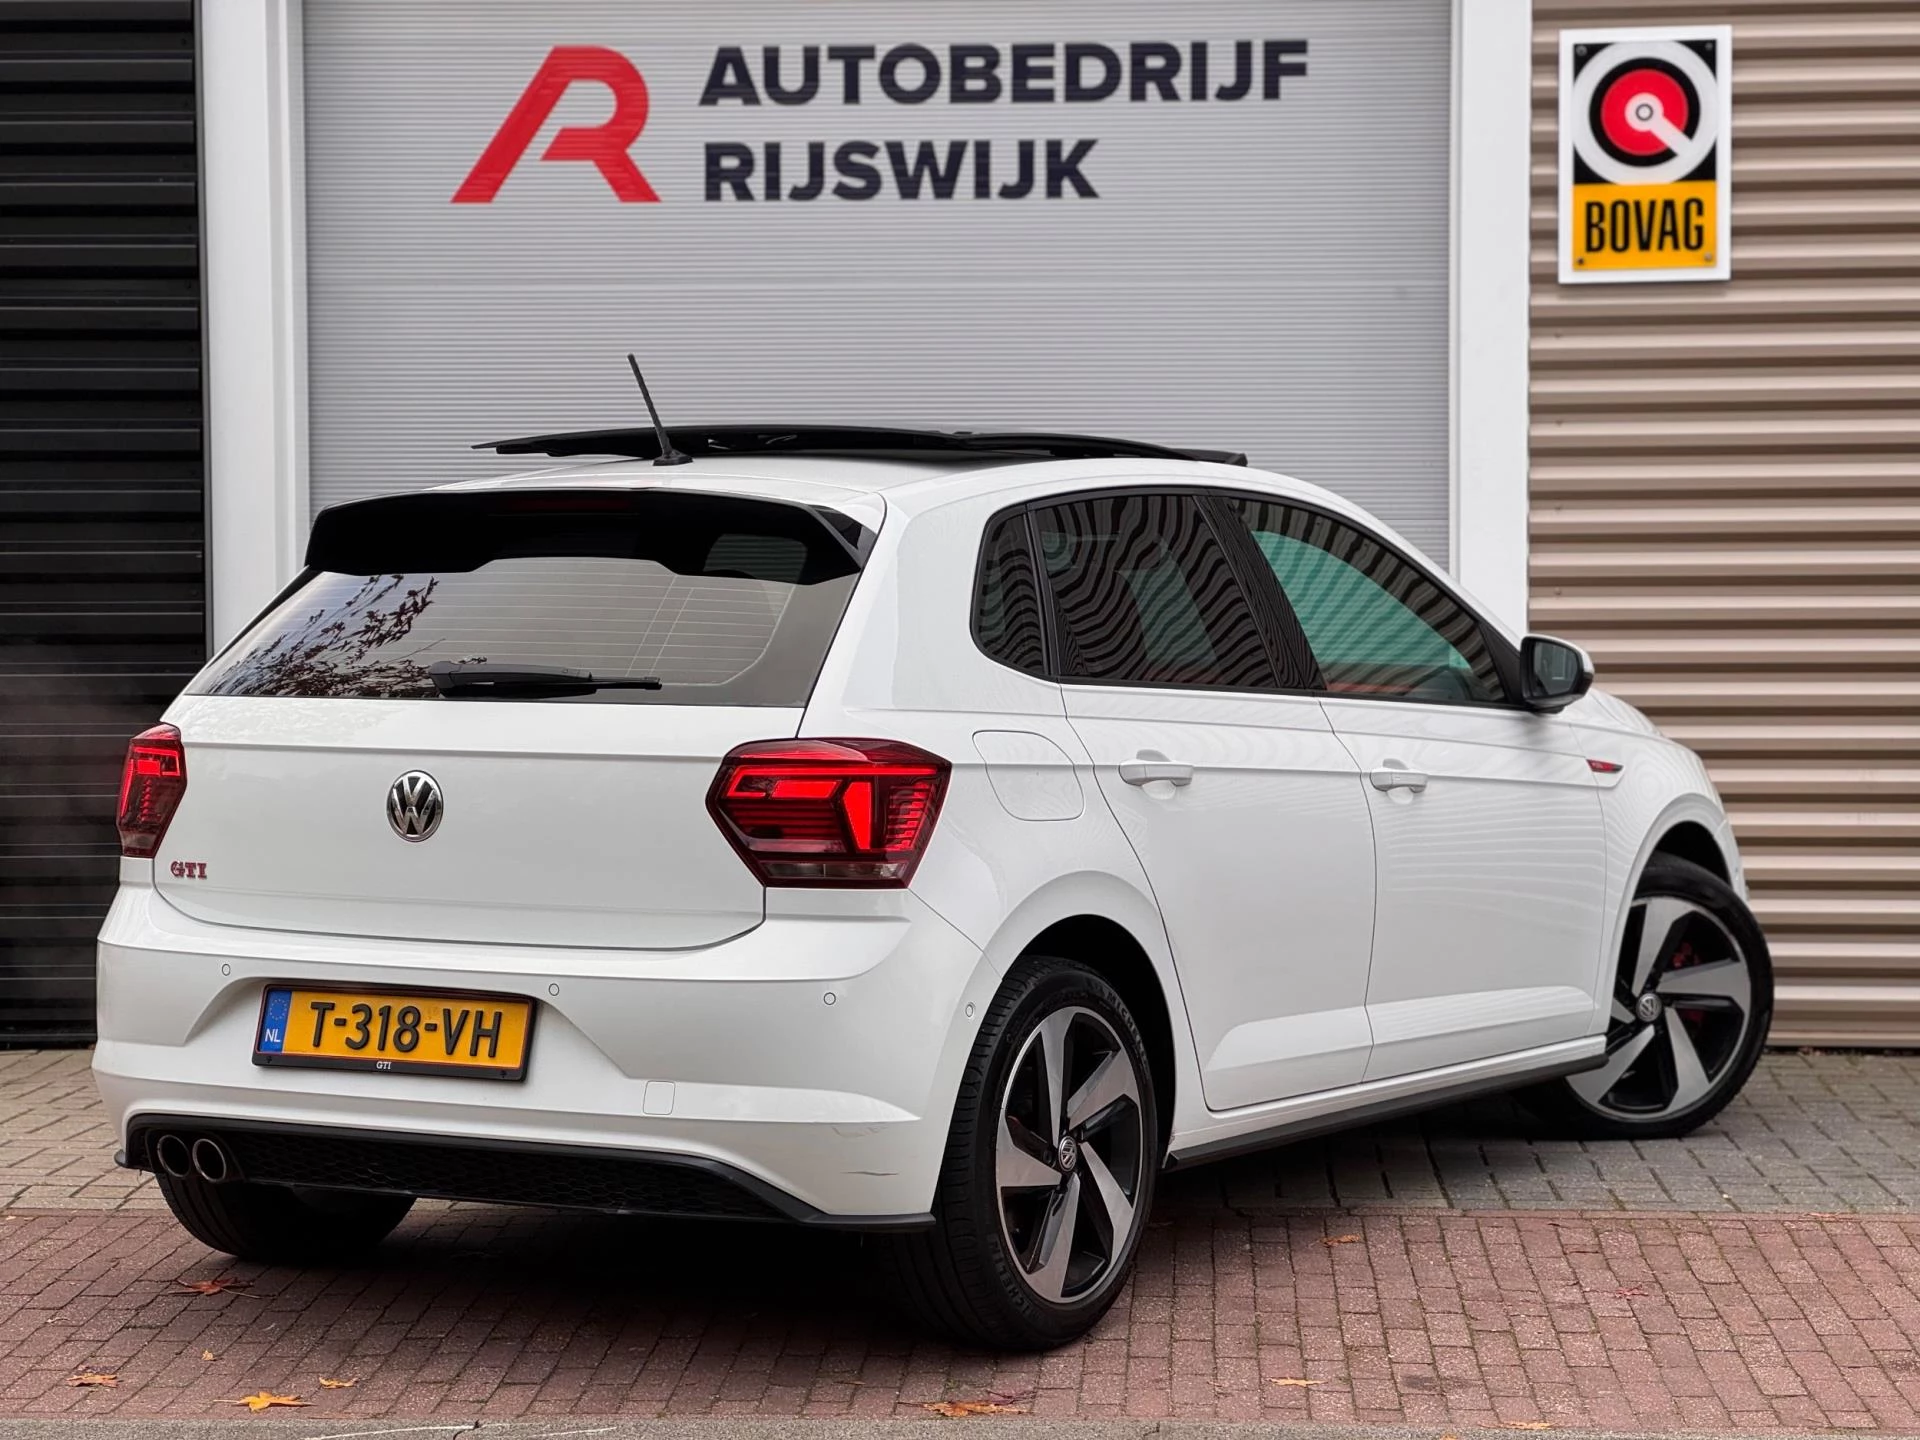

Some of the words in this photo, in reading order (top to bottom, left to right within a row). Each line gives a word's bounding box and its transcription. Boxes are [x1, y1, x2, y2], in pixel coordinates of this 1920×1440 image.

[700, 40, 1307, 105] AUTOBEDRIJF
[705, 140, 1098, 201] RIJSWIJK
[1585, 197, 1704, 254] BOVAG
[170, 861, 208, 879] GTI
[265, 1029, 281, 1043] NL
[310, 1001, 503, 1057] T-318-VH
[376, 1061, 392, 1070] GTI
